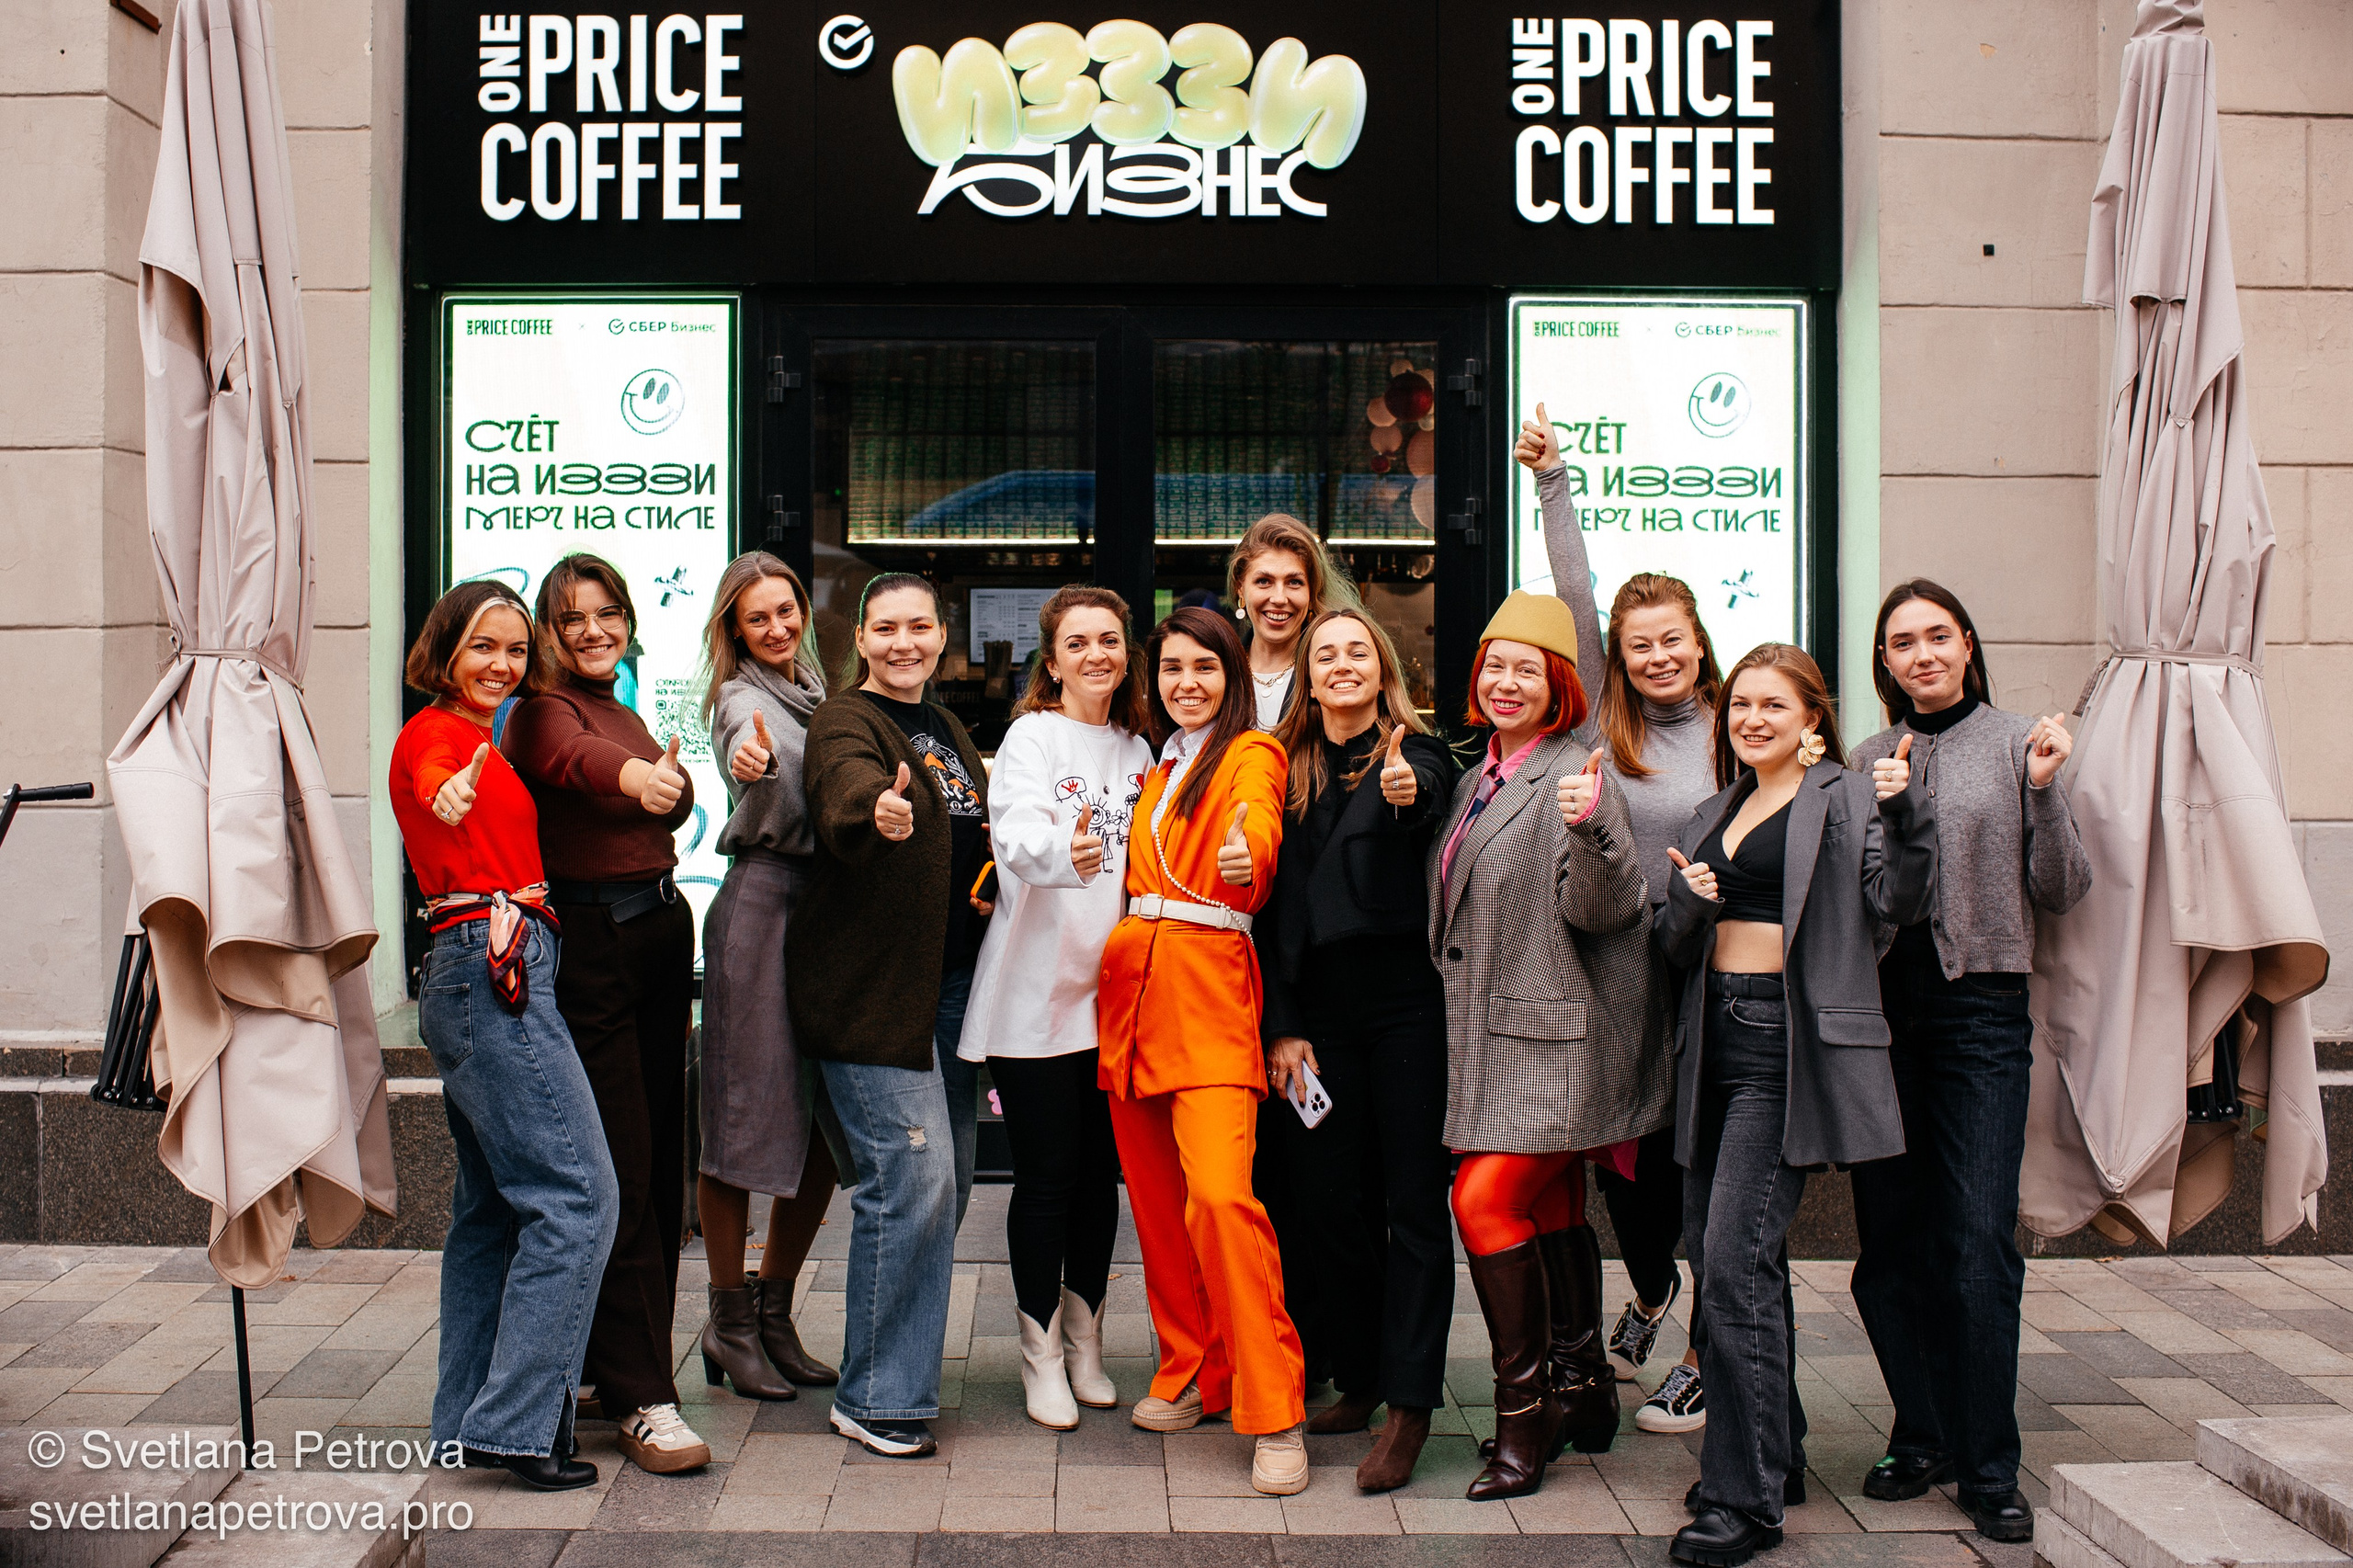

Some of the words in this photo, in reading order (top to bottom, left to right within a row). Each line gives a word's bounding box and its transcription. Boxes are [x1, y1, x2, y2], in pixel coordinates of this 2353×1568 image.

[478, 15, 521, 112] ONE
[529, 14, 744, 112] PRICE
[1512, 17, 1555, 115] ONE
[1563, 18, 1774, 117] PRICE
[481, 121, 743, 221] COFFEE
[1516, 125, 1775, 224] COFFEE
[474, 319, 508, 335] PRICE
[511, 319, 553, 335] COFFEE
[629, 322, 666, 332] СБЕР
[671, 322, 716, 333] Бизнес
[1541, 322, 1575, 337] PRICE
[1578, 322, 1620, 337] COFFEE
[1696, 325, 1733, 335] СБЕР
[465, 506, 563, 531] МЕРЧ
[625, 506, 715, 529] СТИЛЕ
[1692, 509, 1781, 532] СТИЛЕ
